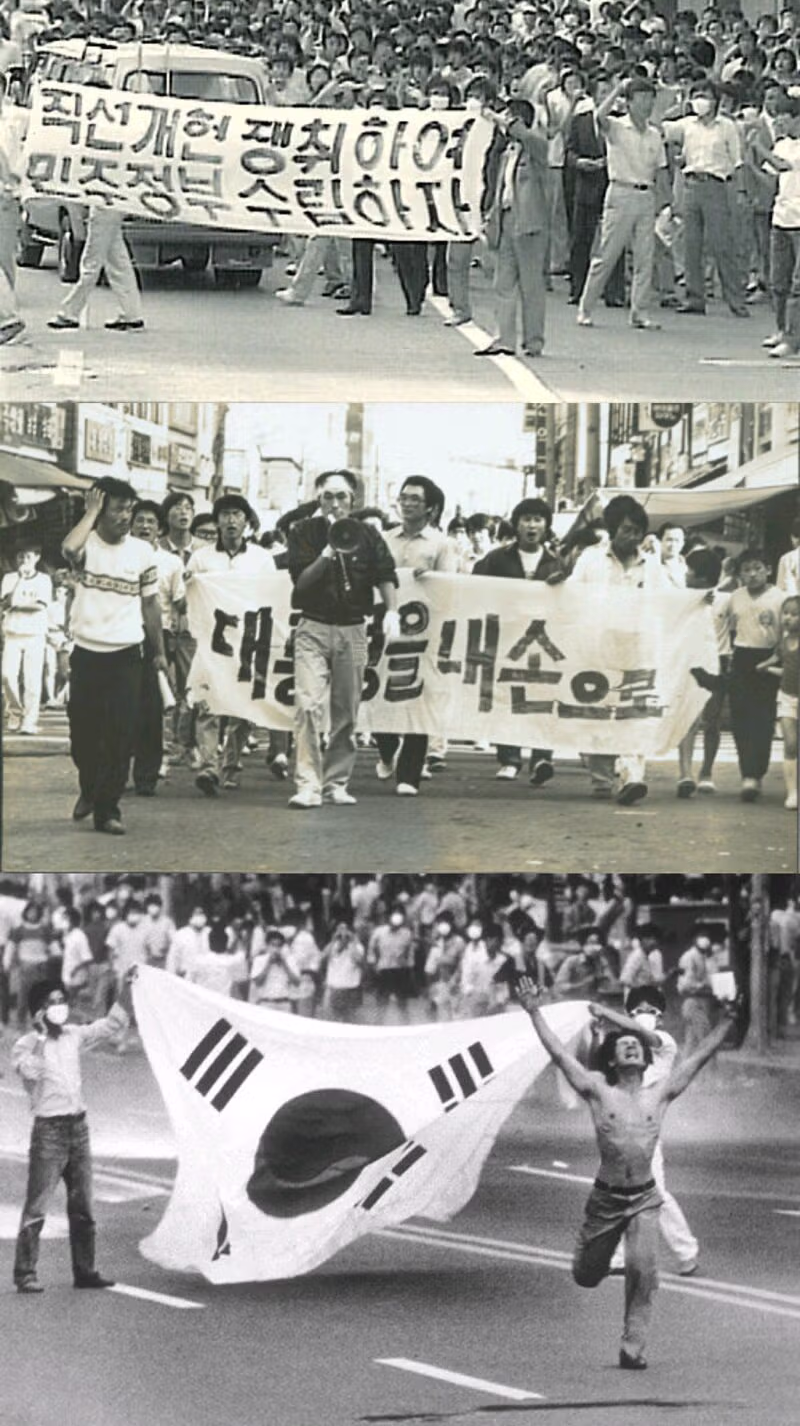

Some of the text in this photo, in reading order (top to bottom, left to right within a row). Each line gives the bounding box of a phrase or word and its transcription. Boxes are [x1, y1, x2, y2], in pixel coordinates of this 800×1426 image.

[41, 87, 475, 175] 직선개헌 쟁취하여
[26, 151, 475, 235] 민주정부 수립하자
[211, 600, 429, 707] 대을
